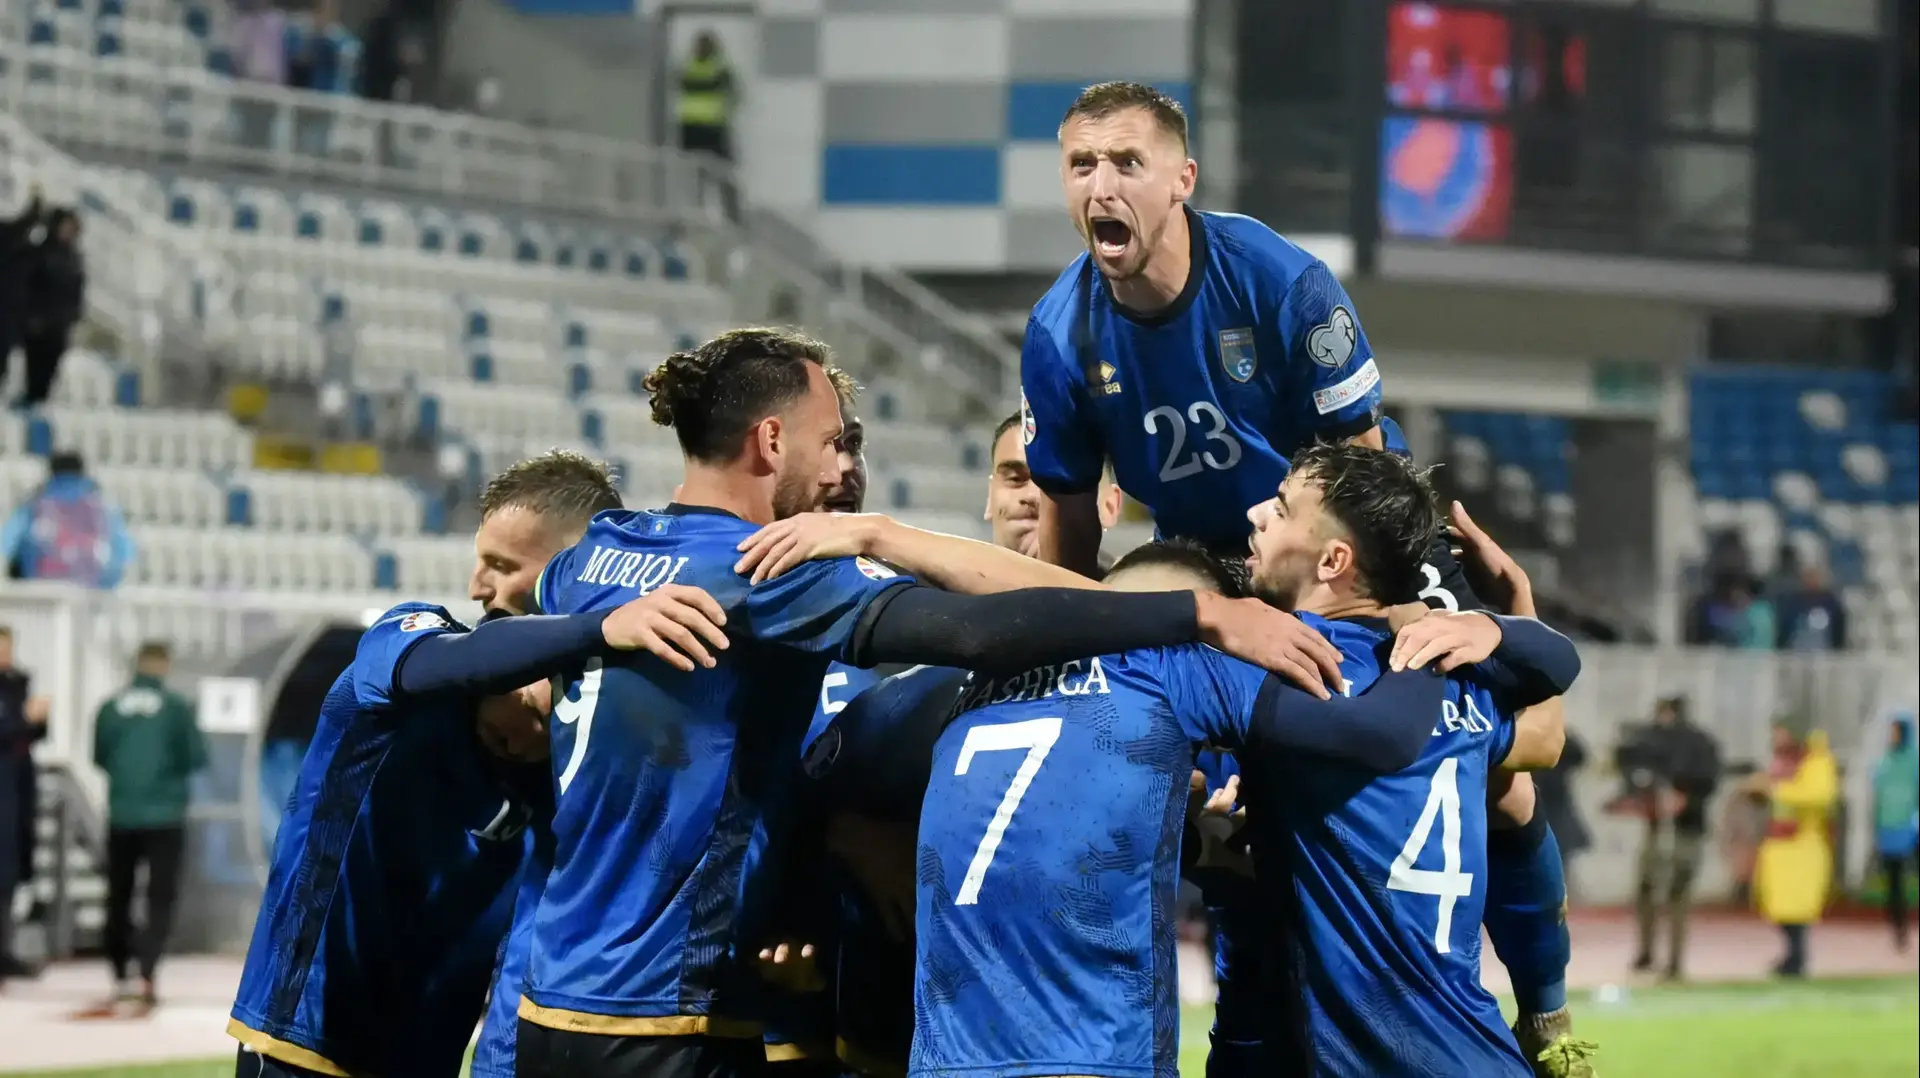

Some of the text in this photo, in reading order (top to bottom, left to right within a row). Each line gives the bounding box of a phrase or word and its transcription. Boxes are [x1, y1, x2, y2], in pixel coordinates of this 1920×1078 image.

[1143, 401, 1242, 483] 23
[577, 545, 689, 596] MURIQI
[952, 656, 1111, 716] RASHICA
[954, 717, 1063, 906] 7
[1386, 757, 1474, 954] 4
